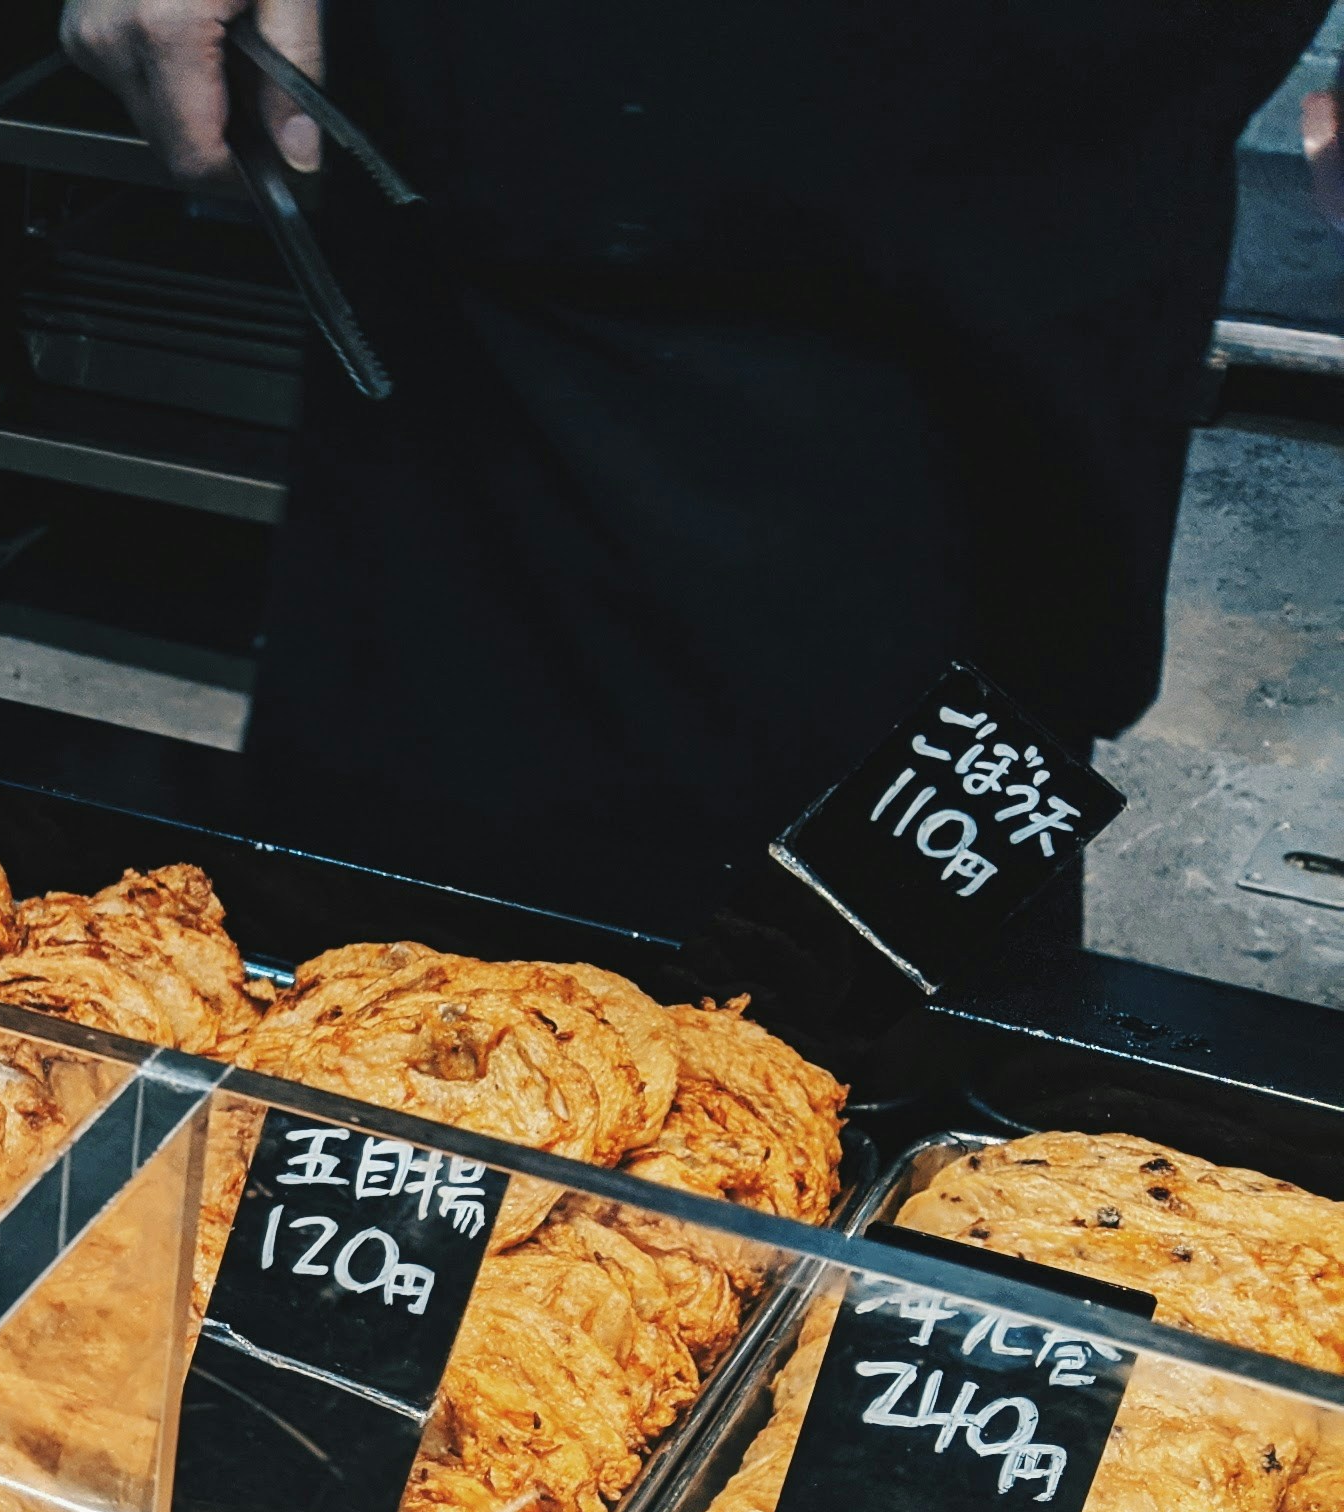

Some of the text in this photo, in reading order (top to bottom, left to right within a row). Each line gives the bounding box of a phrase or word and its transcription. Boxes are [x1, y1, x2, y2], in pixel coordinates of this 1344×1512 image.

[870, 767, 998, 897] 110円
[276, 1128, 486, 1239] 五目揚
[261, 1204, 435, 1315] 120円
[855, 1361, 1067, 1502] 240円
